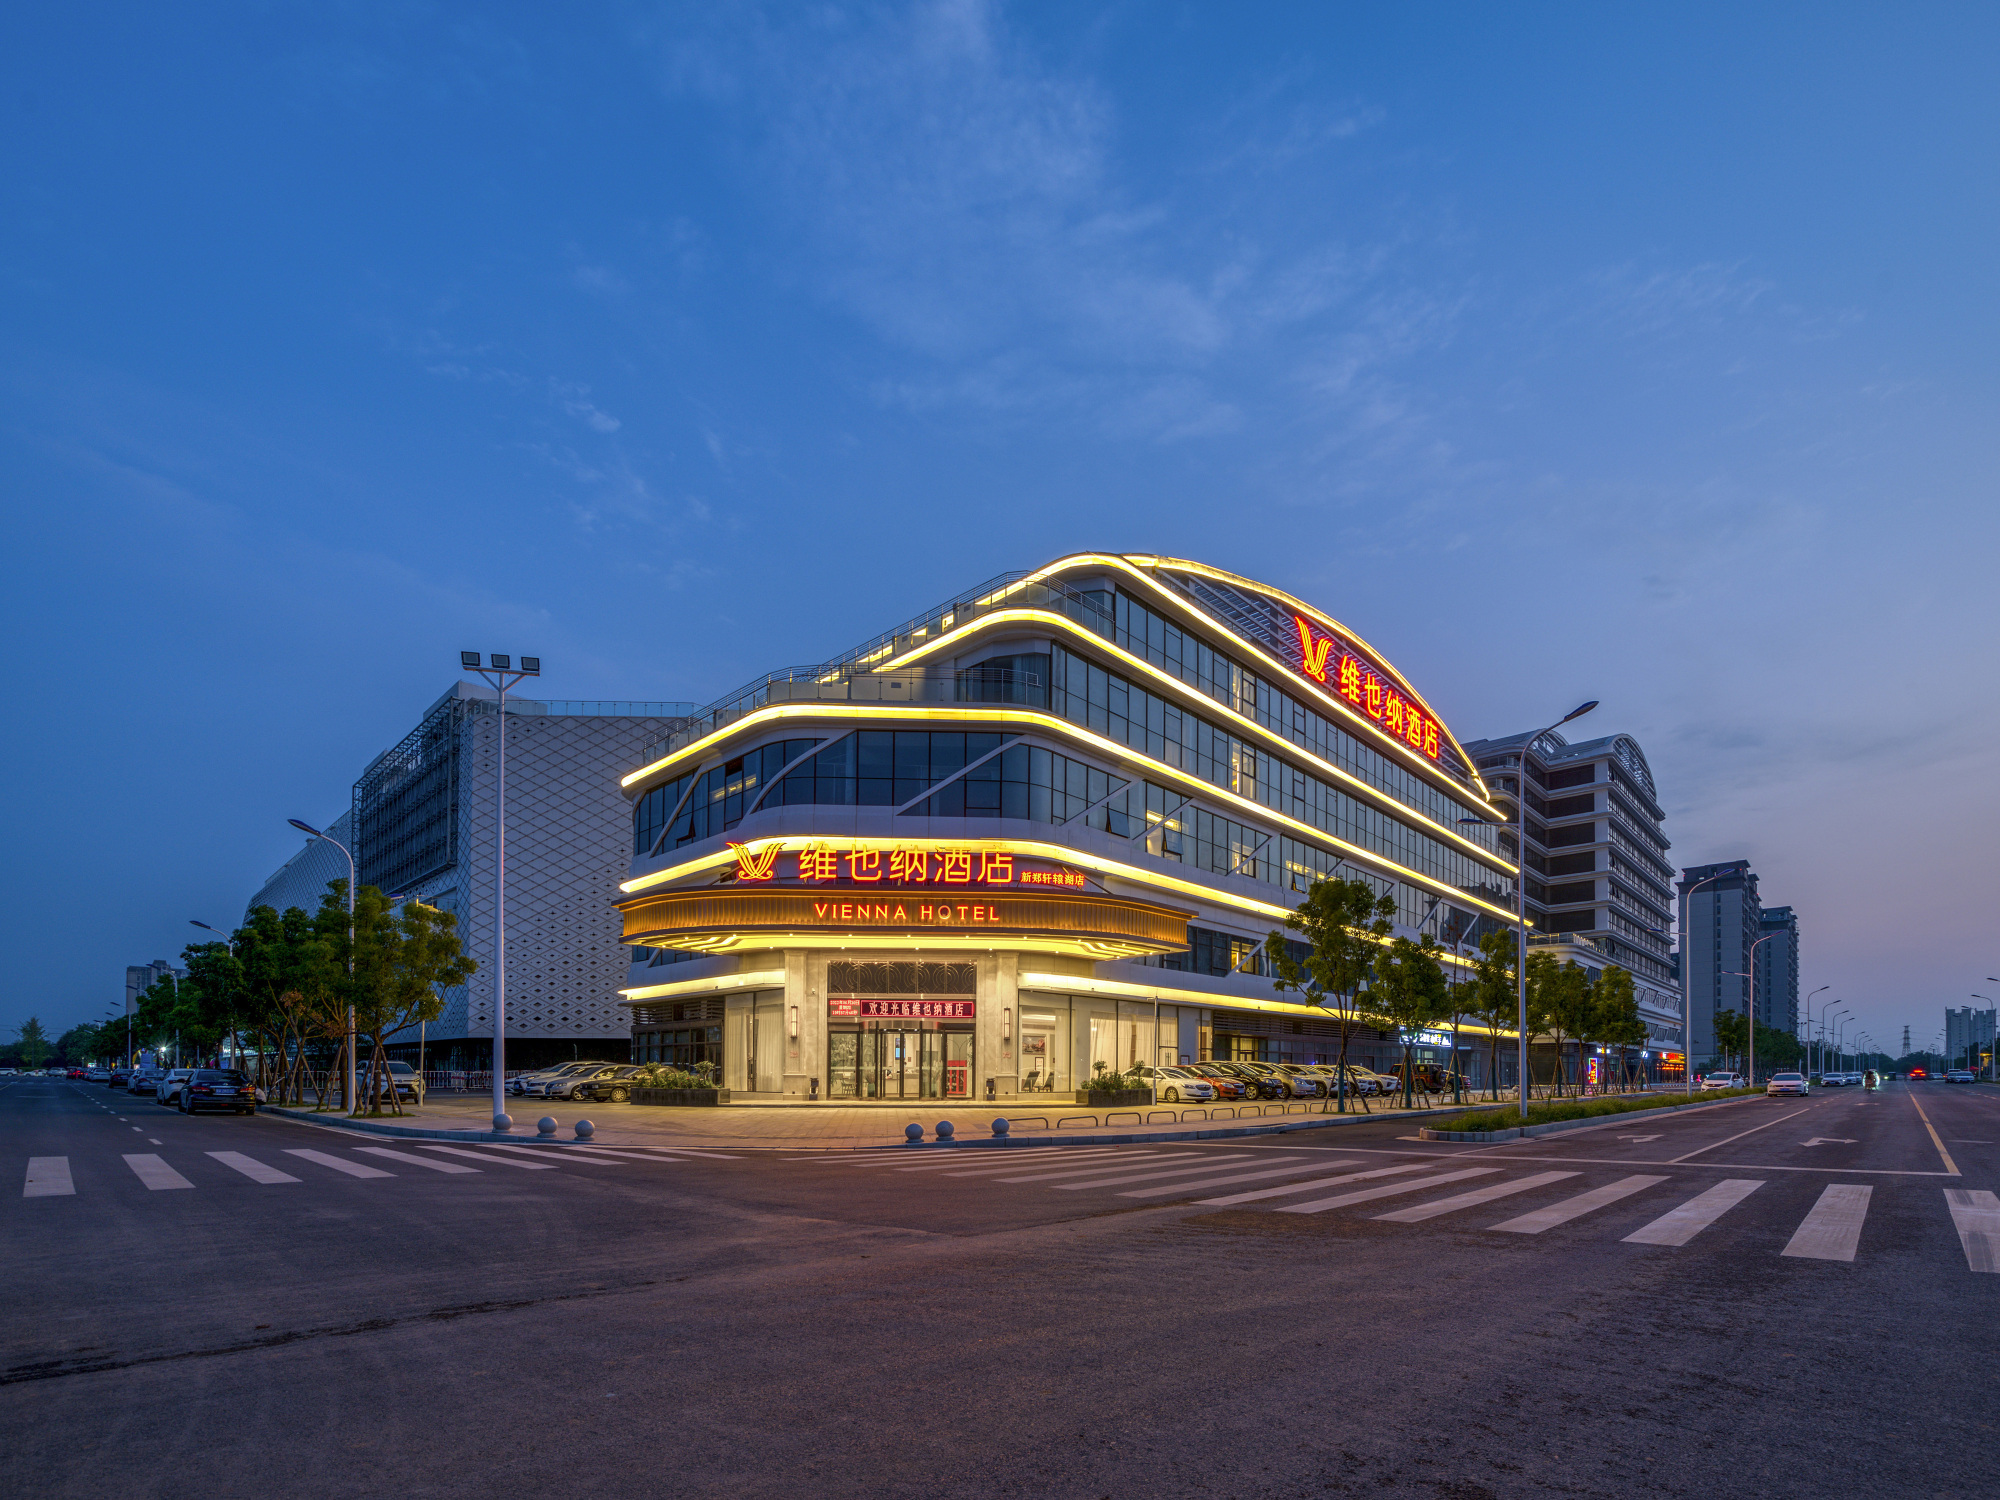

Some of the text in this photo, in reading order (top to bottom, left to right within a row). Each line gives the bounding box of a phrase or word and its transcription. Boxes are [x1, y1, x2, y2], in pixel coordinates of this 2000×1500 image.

[1340, 655, 1438, 759] 维也纳酒店
[799, 843, 1015, 884] 维也纳酒店
[1021, 871, 1085, 886] 新郑轩辕湖店
[815, 903, 1000, 921] VIENNA HOTEL
[868, 1001, 964, 1016] 欢迎光临维也纳酒店
